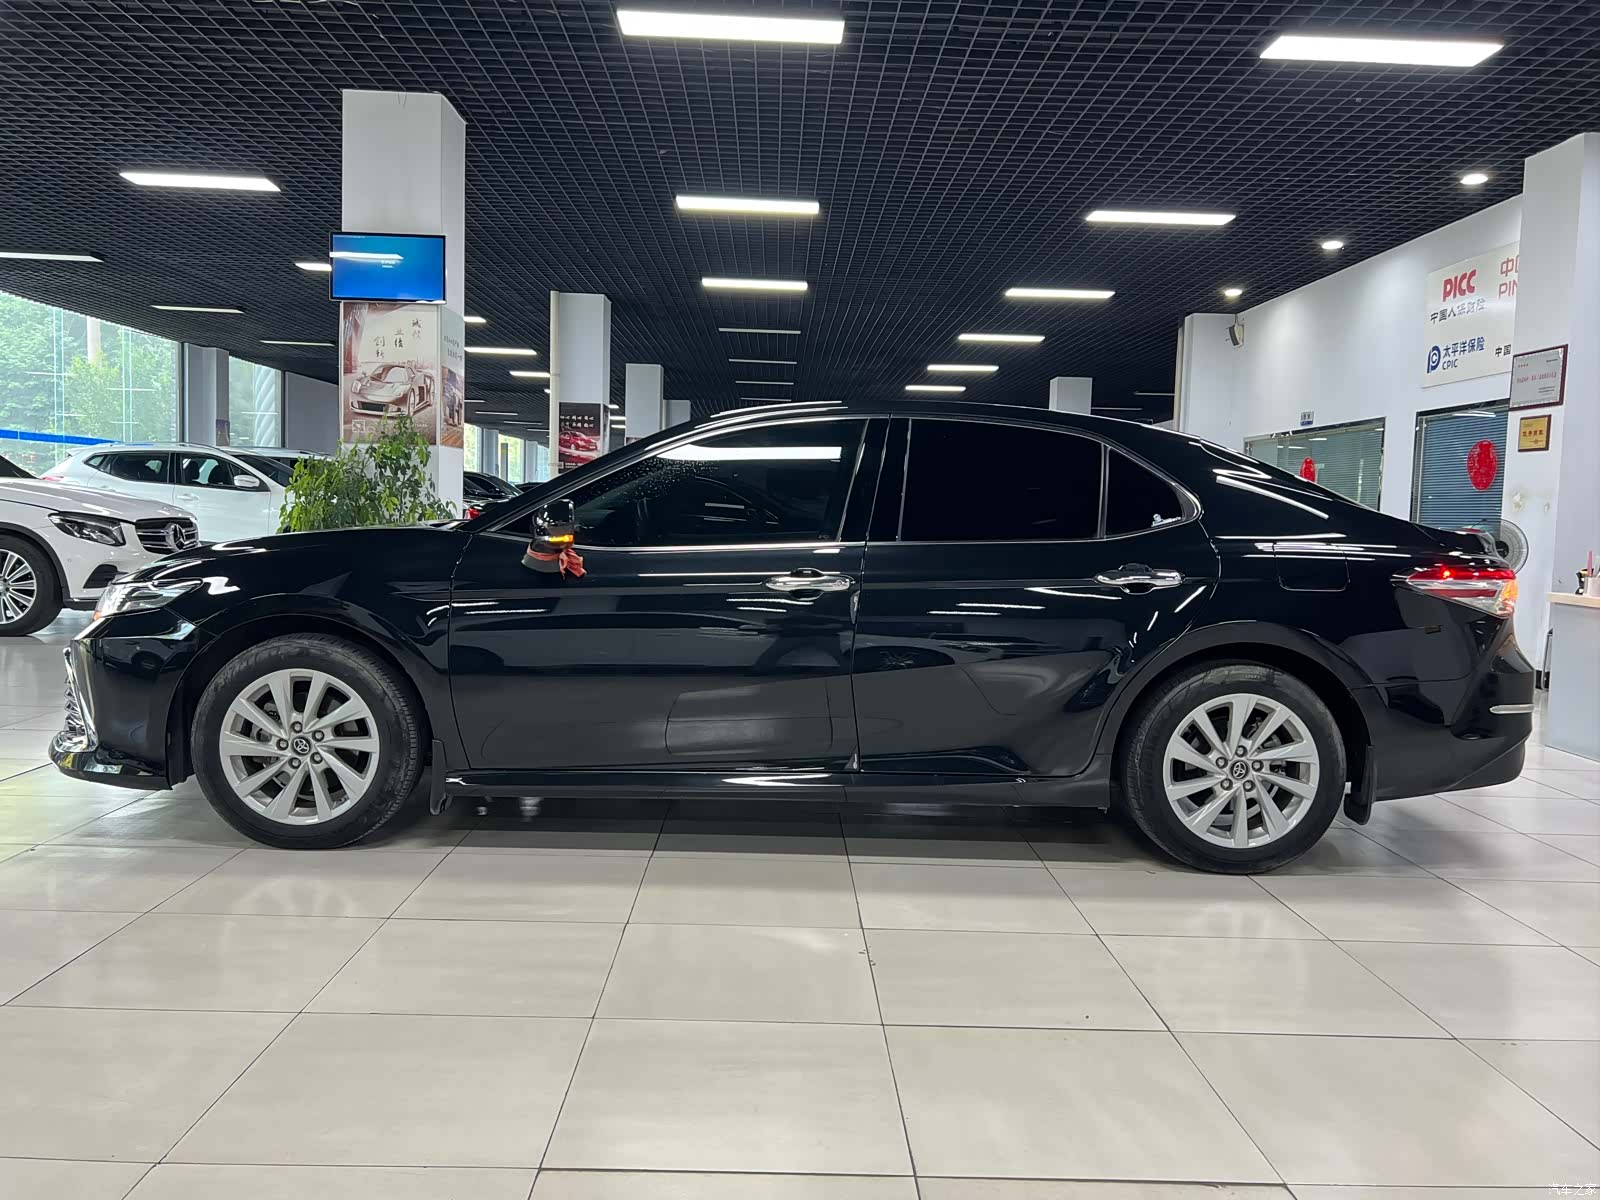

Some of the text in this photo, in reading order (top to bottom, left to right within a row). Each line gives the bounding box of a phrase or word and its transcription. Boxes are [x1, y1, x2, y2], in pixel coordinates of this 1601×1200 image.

[1500, 255, 1519, 277] 中
[1443, 269, 1477, 302] PICC
[1442, 336, 1485, 359] 太平洋保险
[1441, 358, 1458, 371] CPIC
